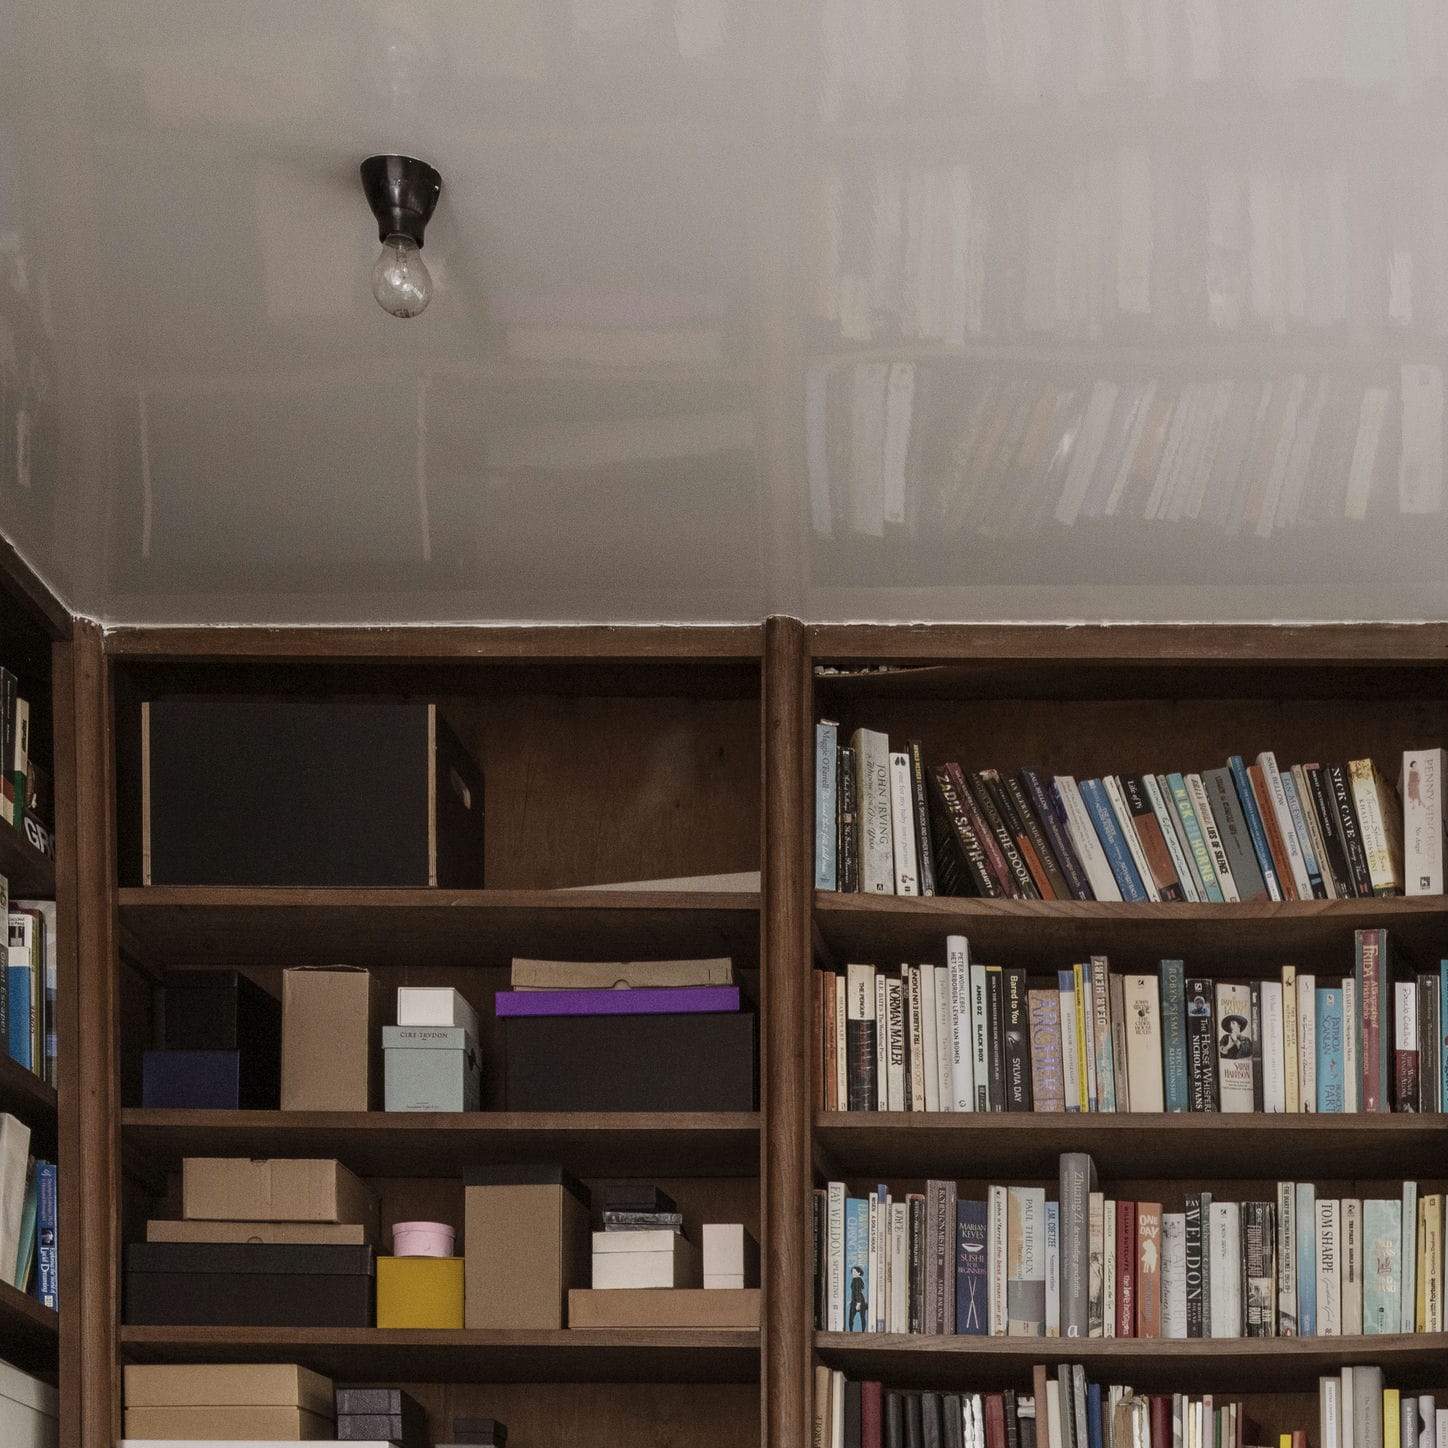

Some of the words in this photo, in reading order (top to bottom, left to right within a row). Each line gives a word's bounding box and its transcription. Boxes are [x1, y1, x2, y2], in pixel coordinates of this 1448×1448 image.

[821, 731, 830, 756] Maggie
[877, 765, 887, 797] JOHN
[935, 774, 962, 813] ZADIE
[1029, 772, 1038, 785] SAUL
[1034, 785, 1048, 810] BELLOW
[1127, 780, 1139, 794] Life
[1134, 801, 1143, 809] Pi
[1266, 757, 1276, 776] SAUL
[1272, 776, 1284, 806] BELLOW
[1286, 832, 1298, 857] Herzog
[1331, 767, 1347, 802] NICK
[1340, 805, 1356, 838] CAVE
[879, 801, 888, 844] IRVING
[1008, 778, 1017, 791] IAN
[1028, 821, 1047, 855] ENDURING
[1043, 856, 1056, 873] LOVE
[1175, 789, 1193, 818] NICK
[1191, 839, 1217, 889] HORNBY
[1358, 799, 1370, 832] KHALED
[1364, 834, 1377, 872] HOSSEINI
[954, 817, 985, 863] SMITH
[979, 867, 993, 889] BEAUTY
[996, 826, 1012, 848] THE
[1009, 851, 1030, 886] DOOR
[1206, 826, 1216, 839] LIES
[1214, 851, 1229, 875] SILENCE
[957, 952, 965, 973] PETER
[1094, 960, 1106, 993] HENRY
[1362, 944, 1378, 977] FRIDA
[950, 966, 958, 1005] VERBORGEN
[958, 974, 966, 1014] WOHLLEBEN
[1009, 976, 1019, 999] Bared
[1168, 968, 1178, 1005] ROBYN
[888, 984, 901, 1027] NORMAN
[976, 1006, 982, 1016] OZ
[1010, 1010, 1019, 1024] You
[1011, 1001, 1018, 1009] to
[1096, 998, 1106, 1025] DEAR
[1031, 996, 1061, 1093] ARCHER
[1169, 1007, 1178, 1045] SISMAN
[890, 1028, 903, 1066] MAILER
[1192, 1035, 1201, 1079] NICHOLAS
[1011, 1057, 1020, 1086] SYLVIA
[1012, 1086, 1021, 1103] DAY
[1194, 1082, 1203, 1109] EVANS
[830, 1186, 840, 1204] FAY
[1072, 1171, 1084, 1211] Zhuang
[894, 1208, 904, 1233] JOYCE
[1025, 1199, 1033, 1222] PAUL
[1074, 1212, 1084, 1224] Zi
[1139, 1215, 1158, 1226] ONE
[1321, 1203, 1333, 1229] TOM
[831, 1208, 841, 1257] WELDON
[1025, 1225, 1033, 1274] THEROUX
[1139, 1226, 1159, 1239] DAY
[1186, 1209, 1201, 1300] WELDON
[1321, 1231, 1334, 1274] SHARPE
[1249, 1306, 1261, 1324] RAND
[1406, 1413, 1414, 1447] handbook
